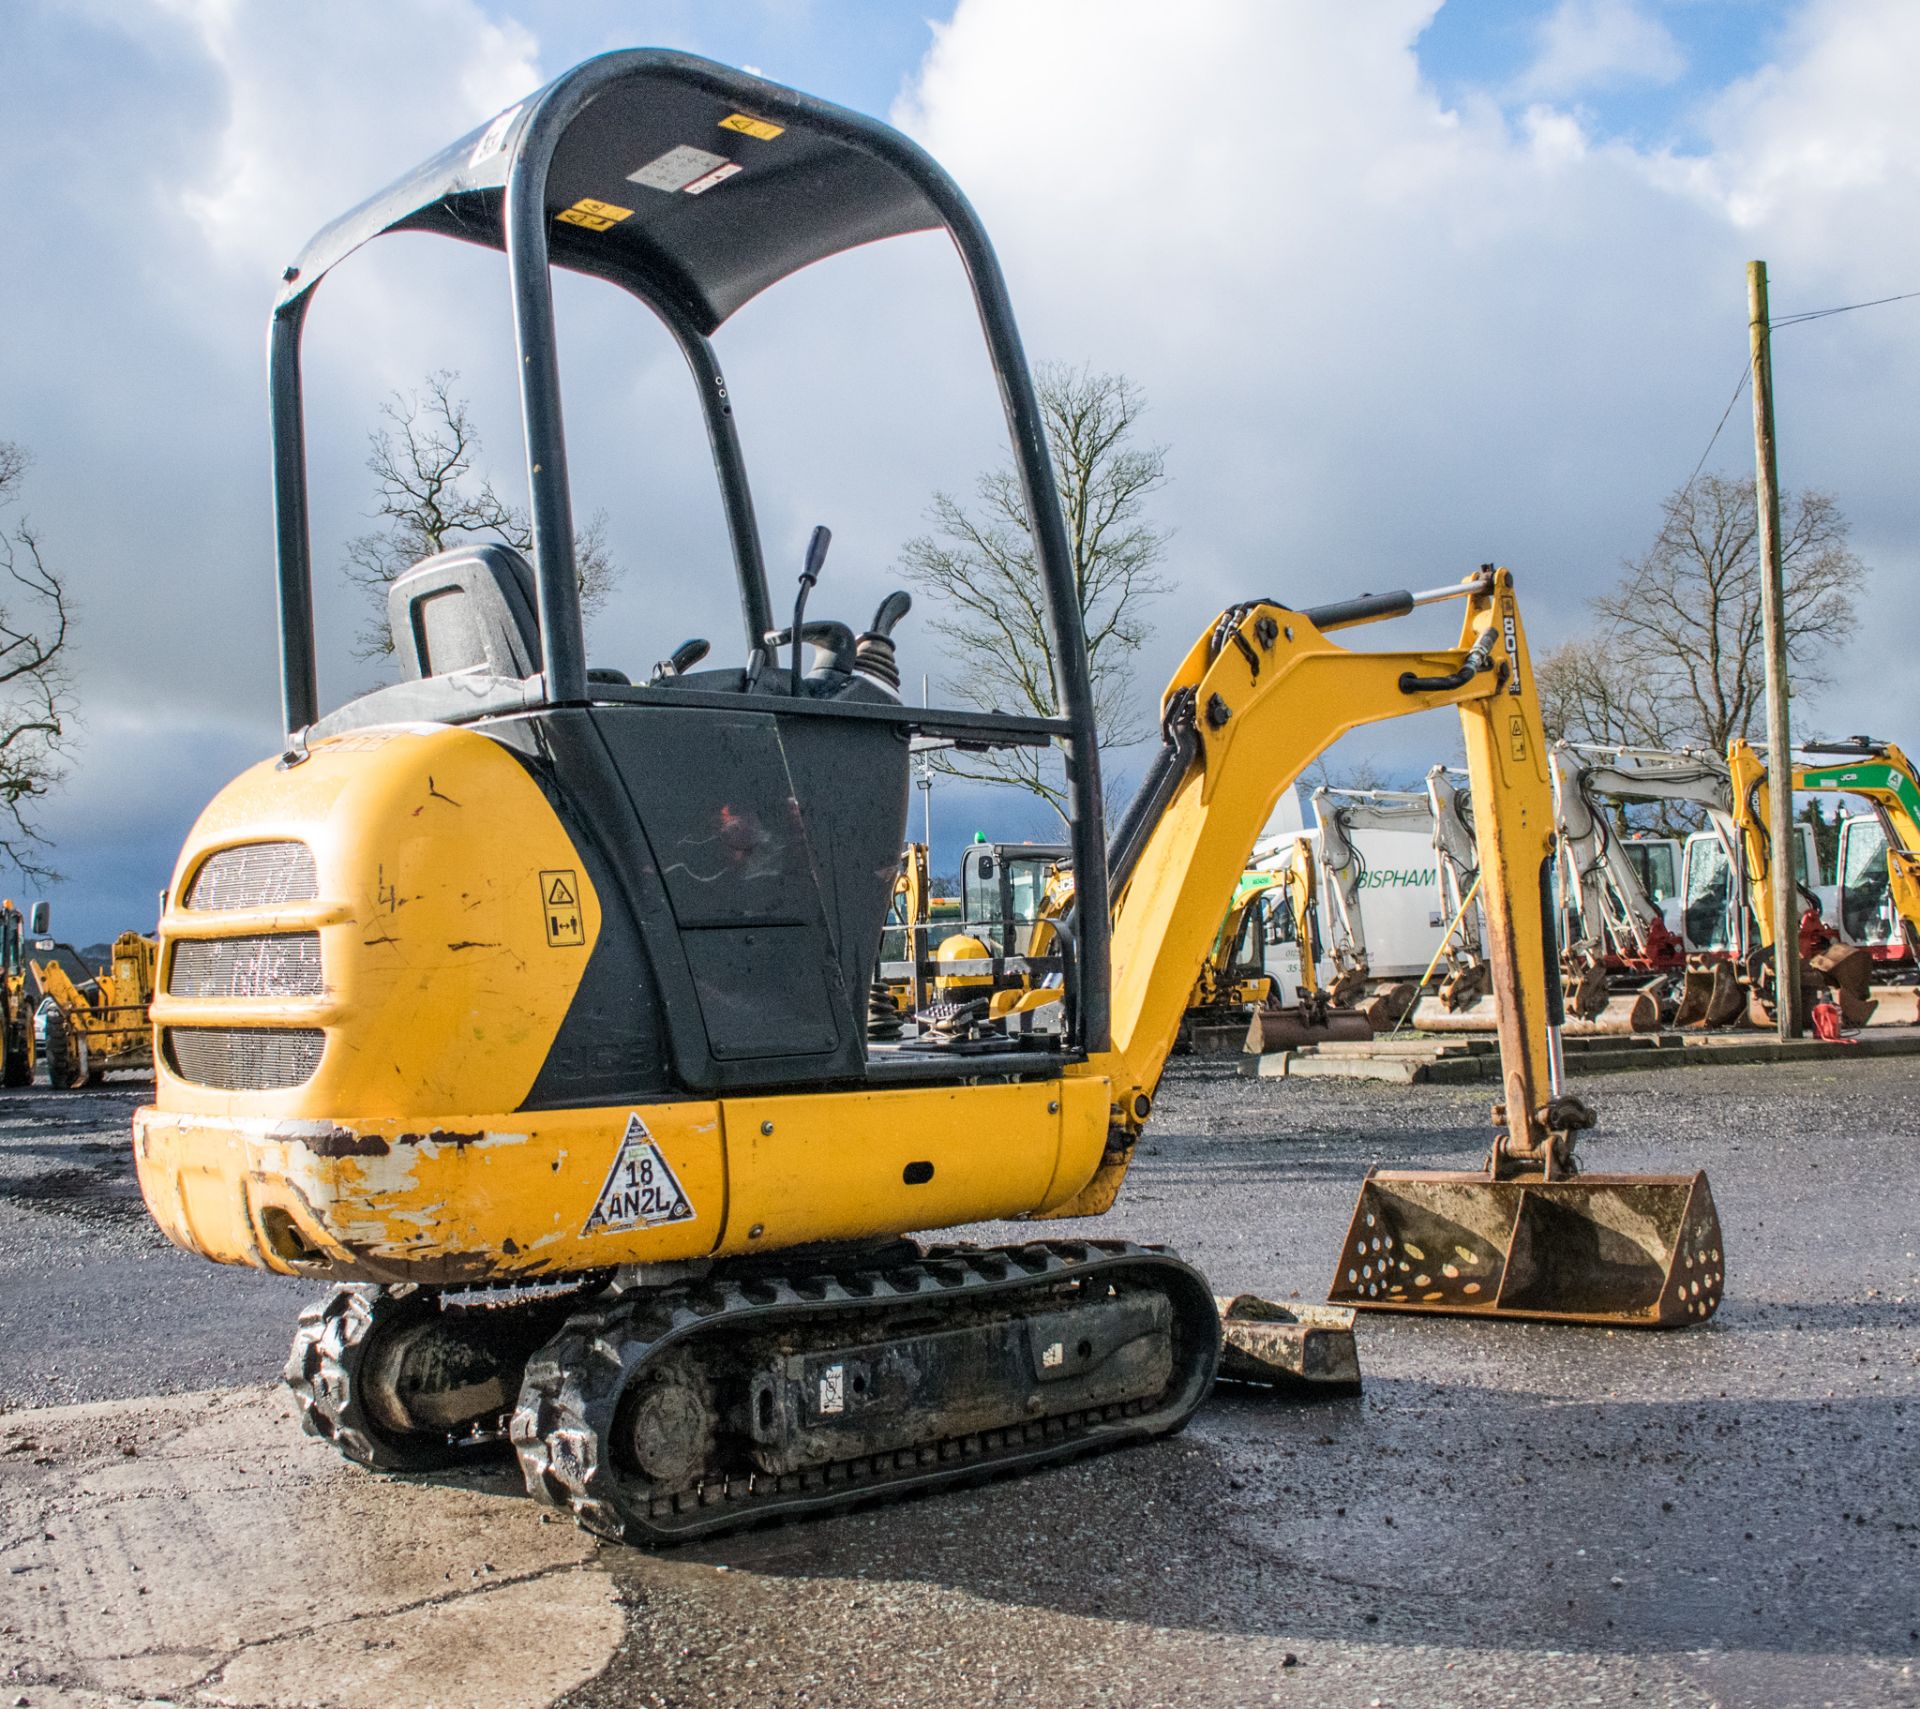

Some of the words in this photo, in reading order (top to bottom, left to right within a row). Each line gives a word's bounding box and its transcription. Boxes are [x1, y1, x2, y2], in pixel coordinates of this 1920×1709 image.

[1840, 773, 1858, 781] JCB
[1358, 868, 1437, 889] BISPHAM
[625, 1158, 654, 1188] 18
[608, 1186, 671, 1219] AN2L
